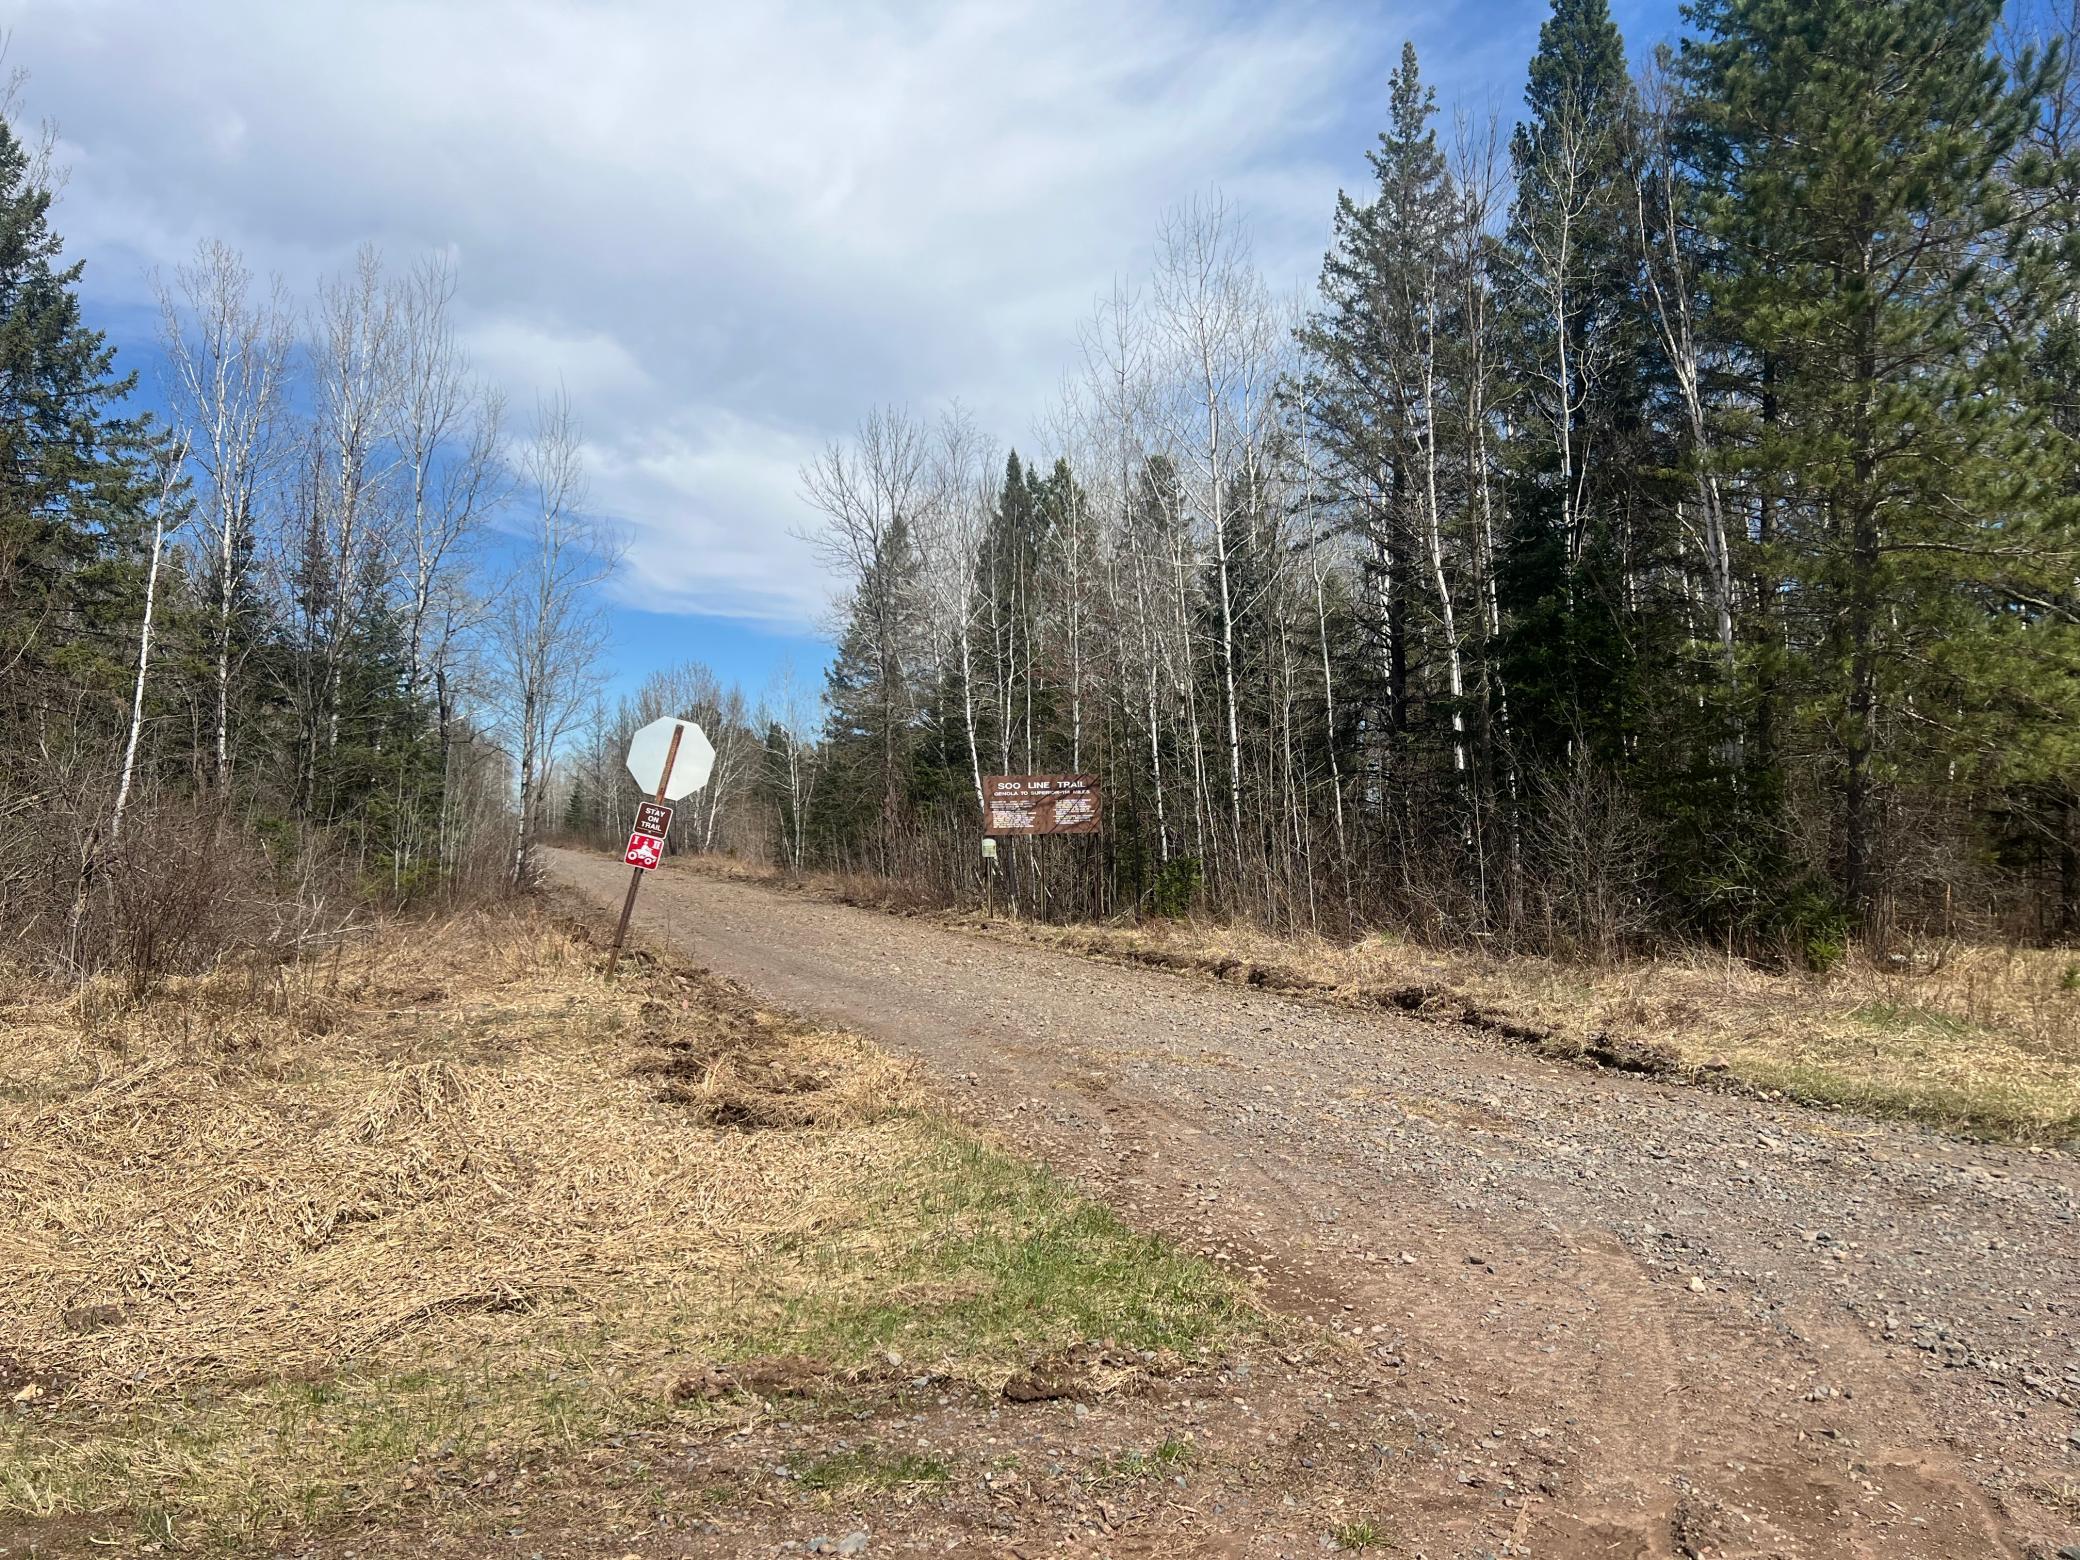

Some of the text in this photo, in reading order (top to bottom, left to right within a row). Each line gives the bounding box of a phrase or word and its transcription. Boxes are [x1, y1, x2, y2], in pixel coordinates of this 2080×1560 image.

[997, 781, 1086, 790] SOO LINE TRAIL
[645, 808, 665, 817] STAY
[647, 815, 660, 824] ON
[641, 821, 662, 831] TRAIL
